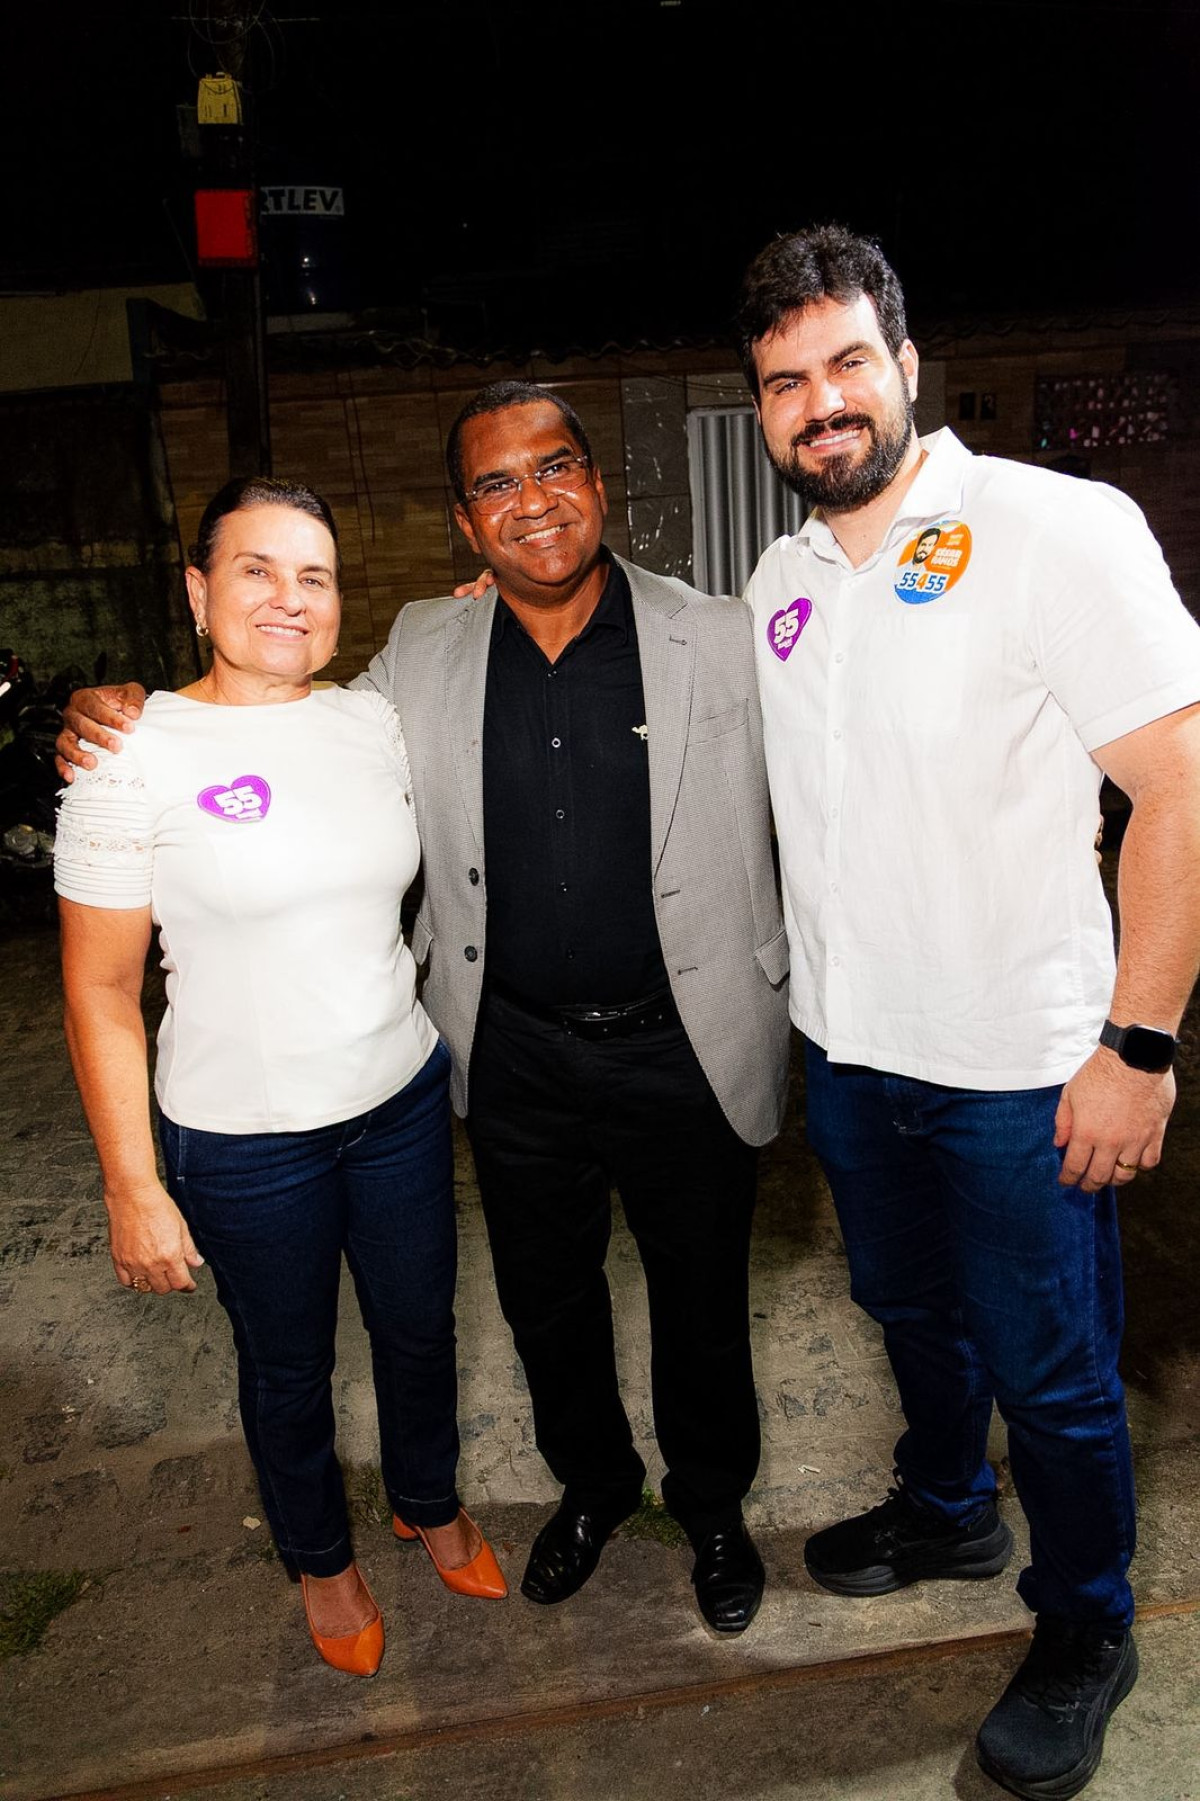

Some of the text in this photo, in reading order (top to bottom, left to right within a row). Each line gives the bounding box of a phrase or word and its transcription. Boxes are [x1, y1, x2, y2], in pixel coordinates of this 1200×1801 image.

[899, 572, 948, 592] 55455
[773, 608, 799, 645] 55
[212, 784, 263, 815] 55
